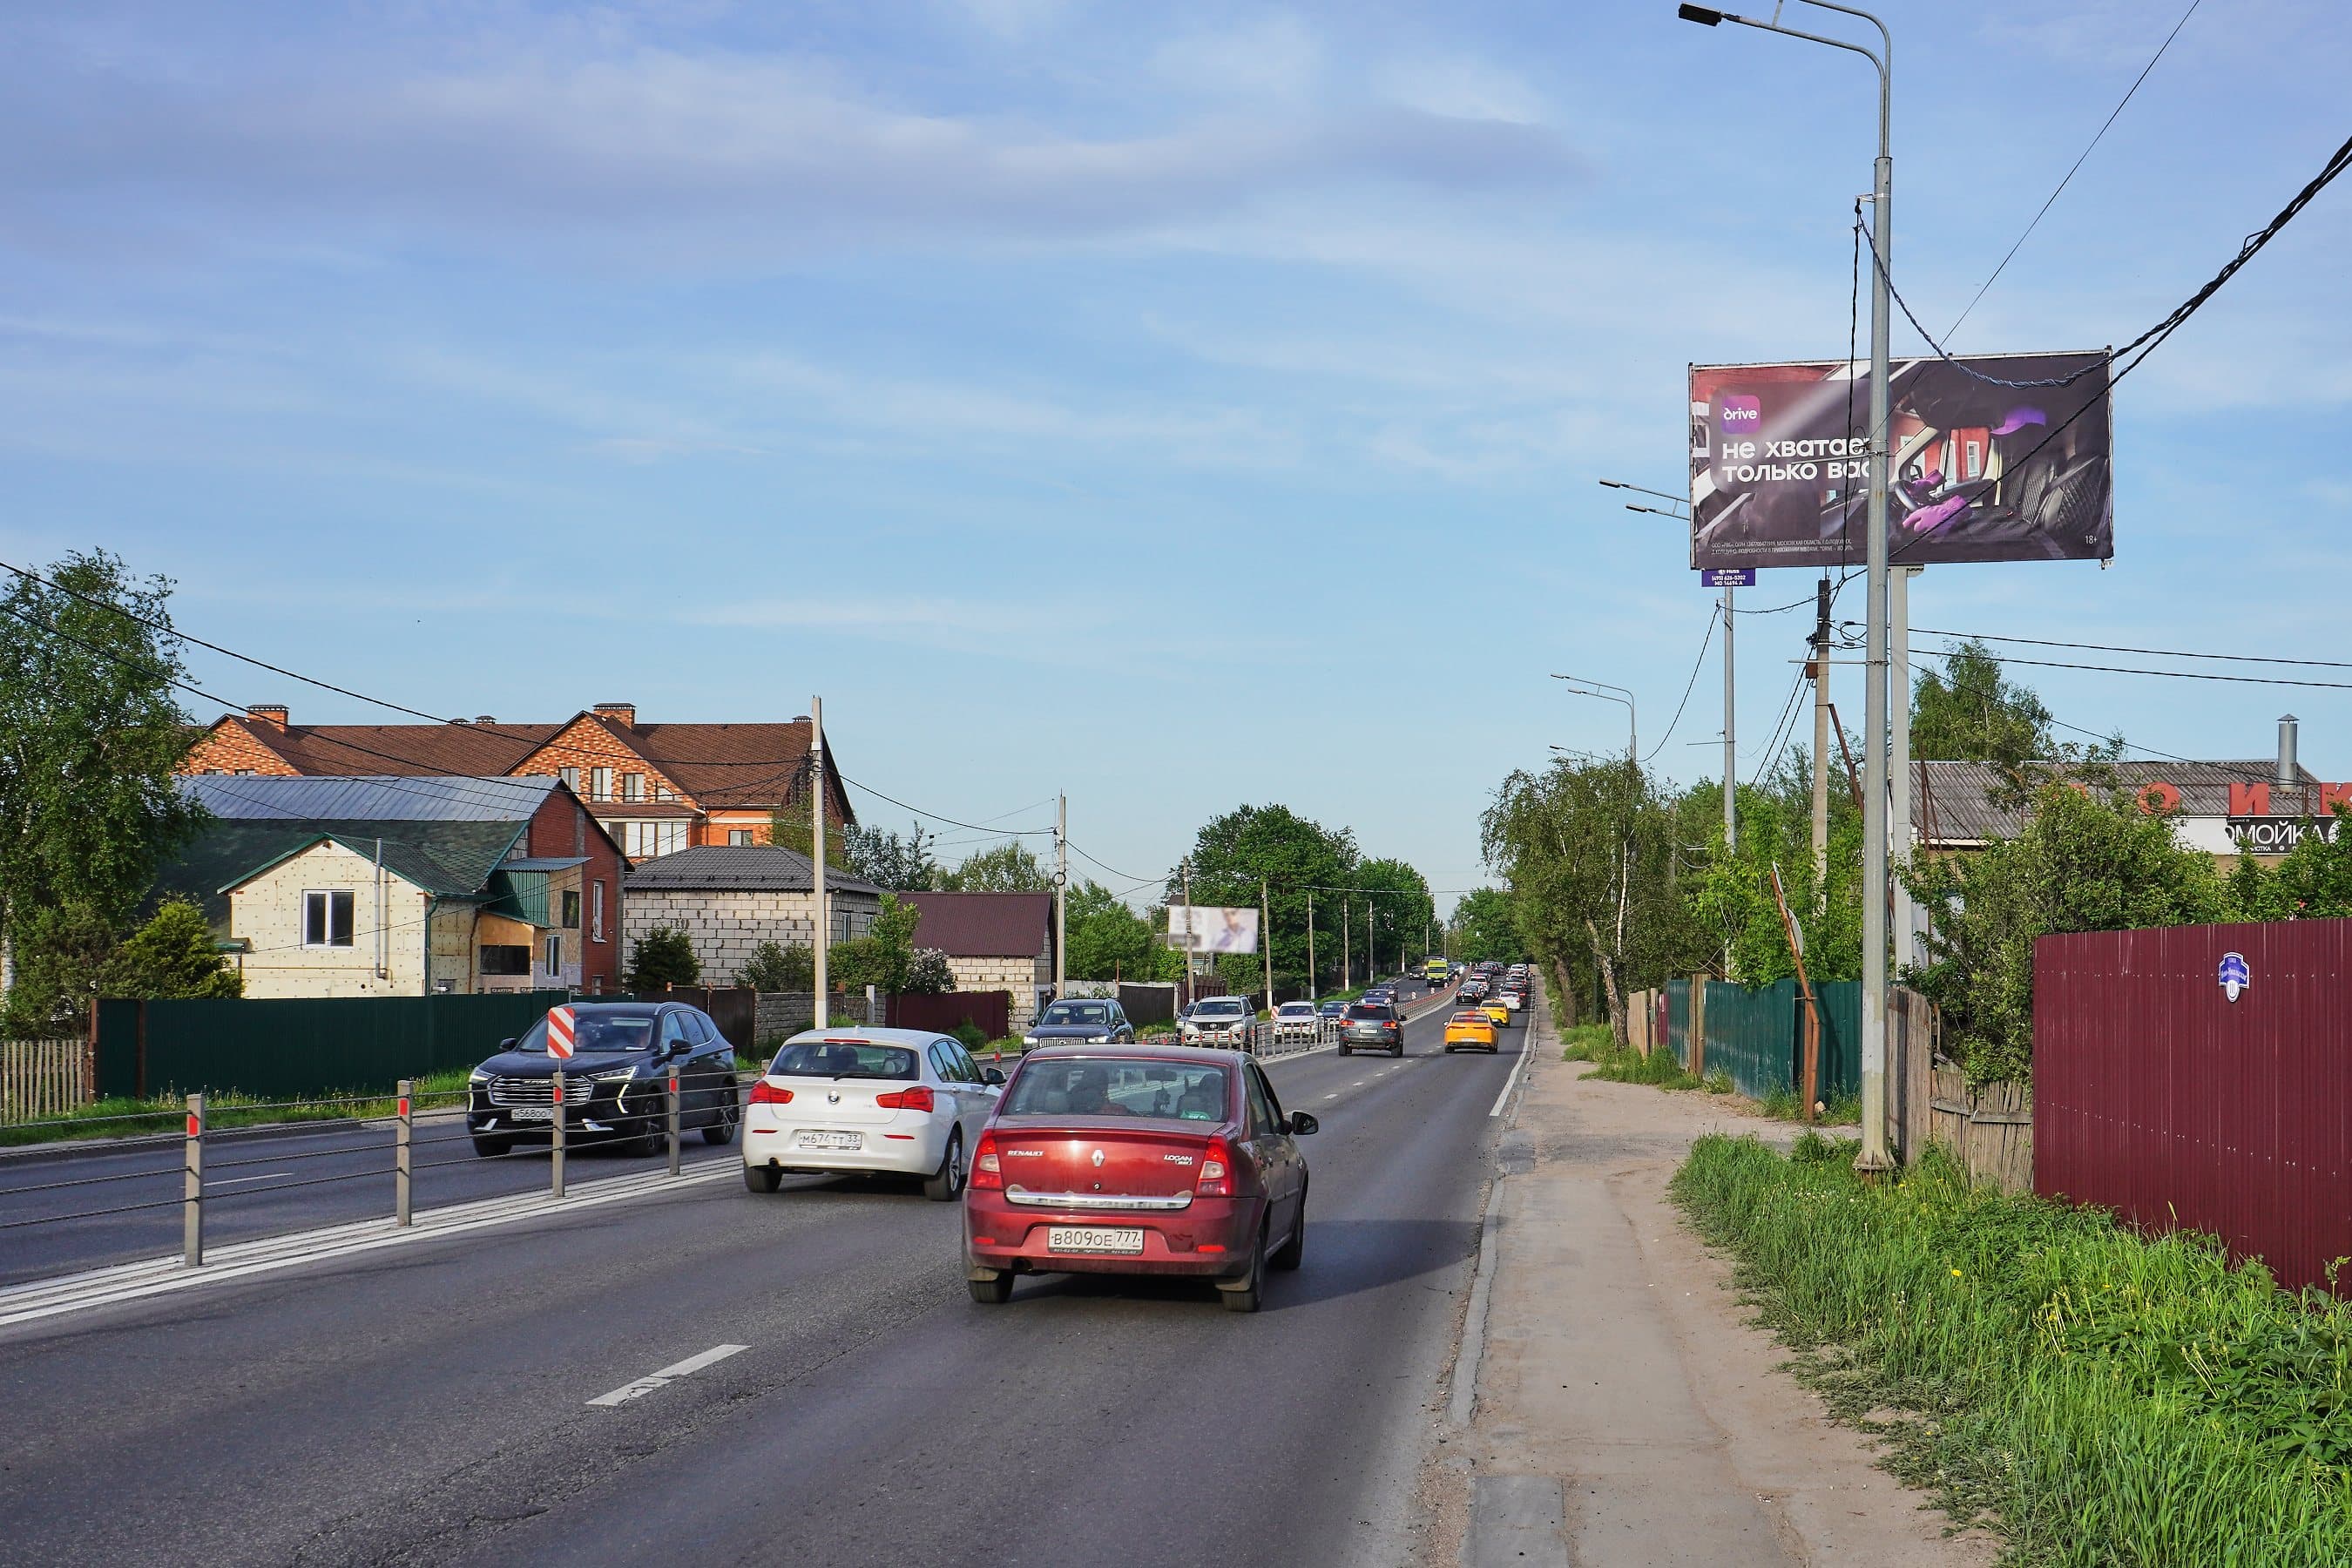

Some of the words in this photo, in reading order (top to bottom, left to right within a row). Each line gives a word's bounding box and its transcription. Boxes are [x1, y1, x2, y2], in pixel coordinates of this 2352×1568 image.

[1723, 407, 1758, 421] drive
[1722, 442, 1756, 459] не
[1721, 463, 1818, 483] только
[2085, 535, 2098, 544] 18+
[1116, 1231, 1139, 1242] 777
